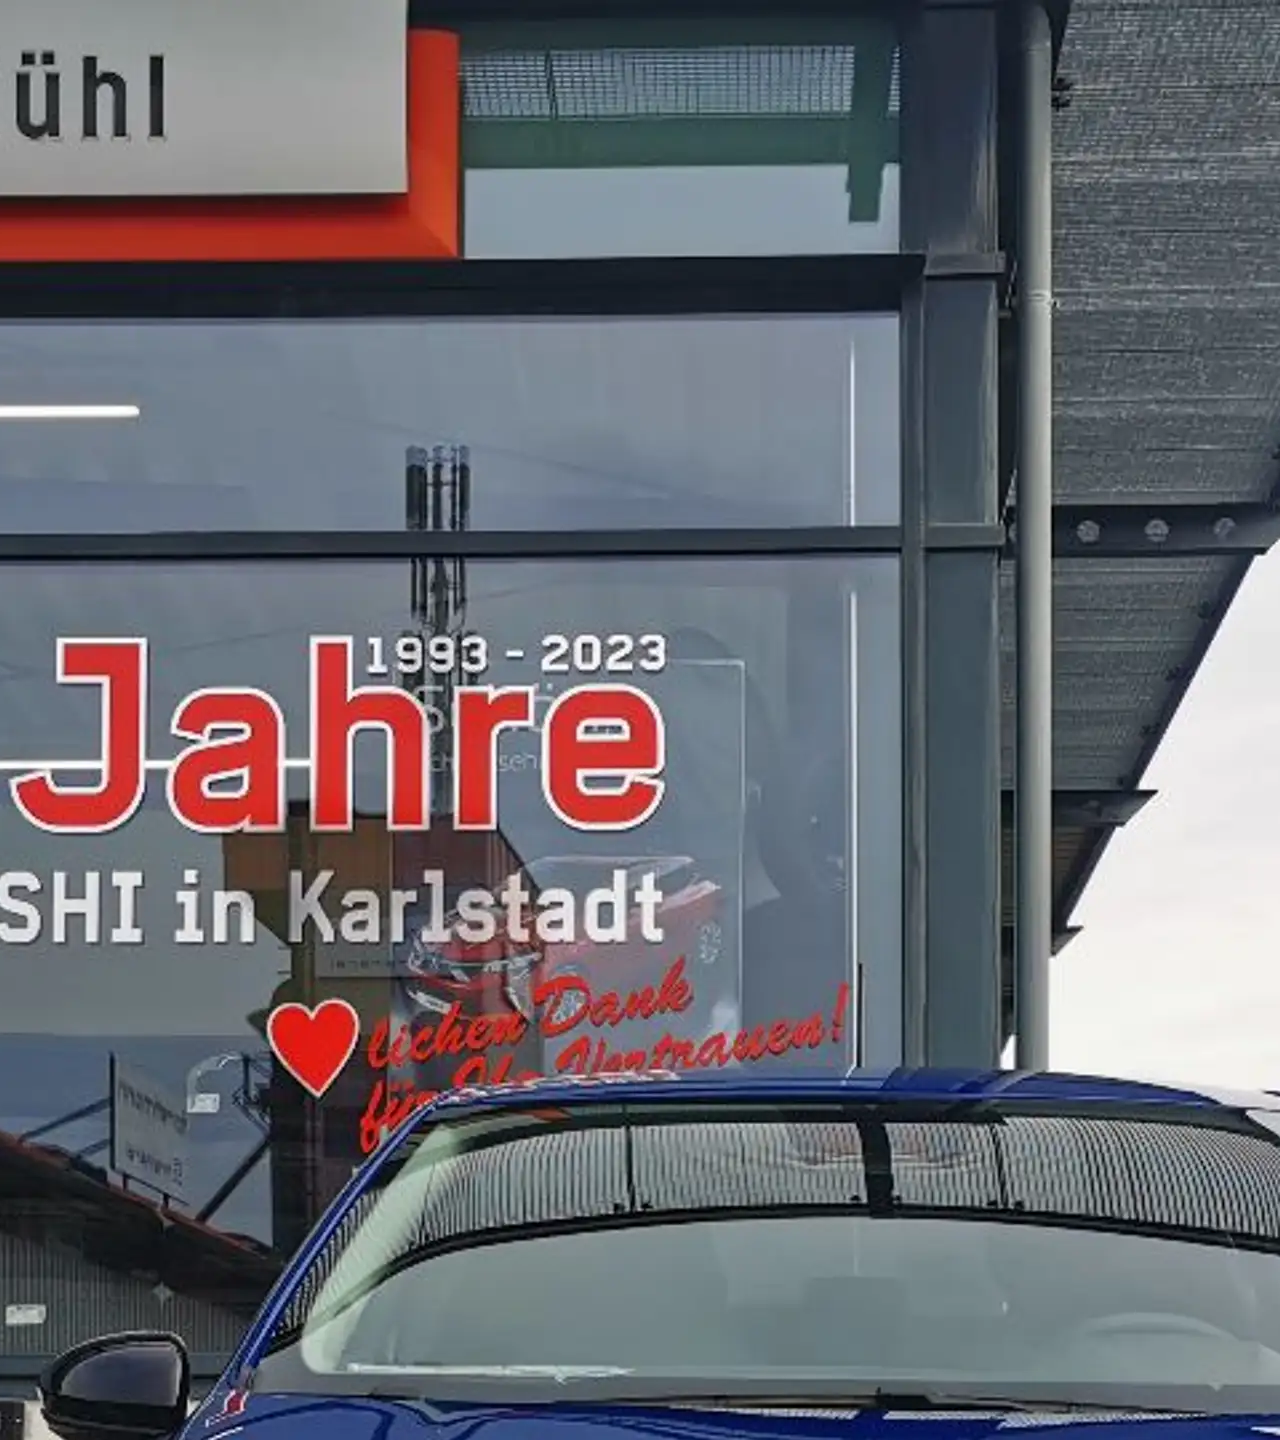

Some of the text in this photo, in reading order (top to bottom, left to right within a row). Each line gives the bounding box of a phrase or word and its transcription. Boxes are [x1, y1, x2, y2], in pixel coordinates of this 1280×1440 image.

[366, 634, 489, 673] 1993
[541, 634, 667, 672] 2023
[9, 633, 667, 834] Jahre
[174, 868, 256, 944] in
[287, 866, 665, 945] Karlstadt
[367, 953, 695, 1069] lichen Dank
